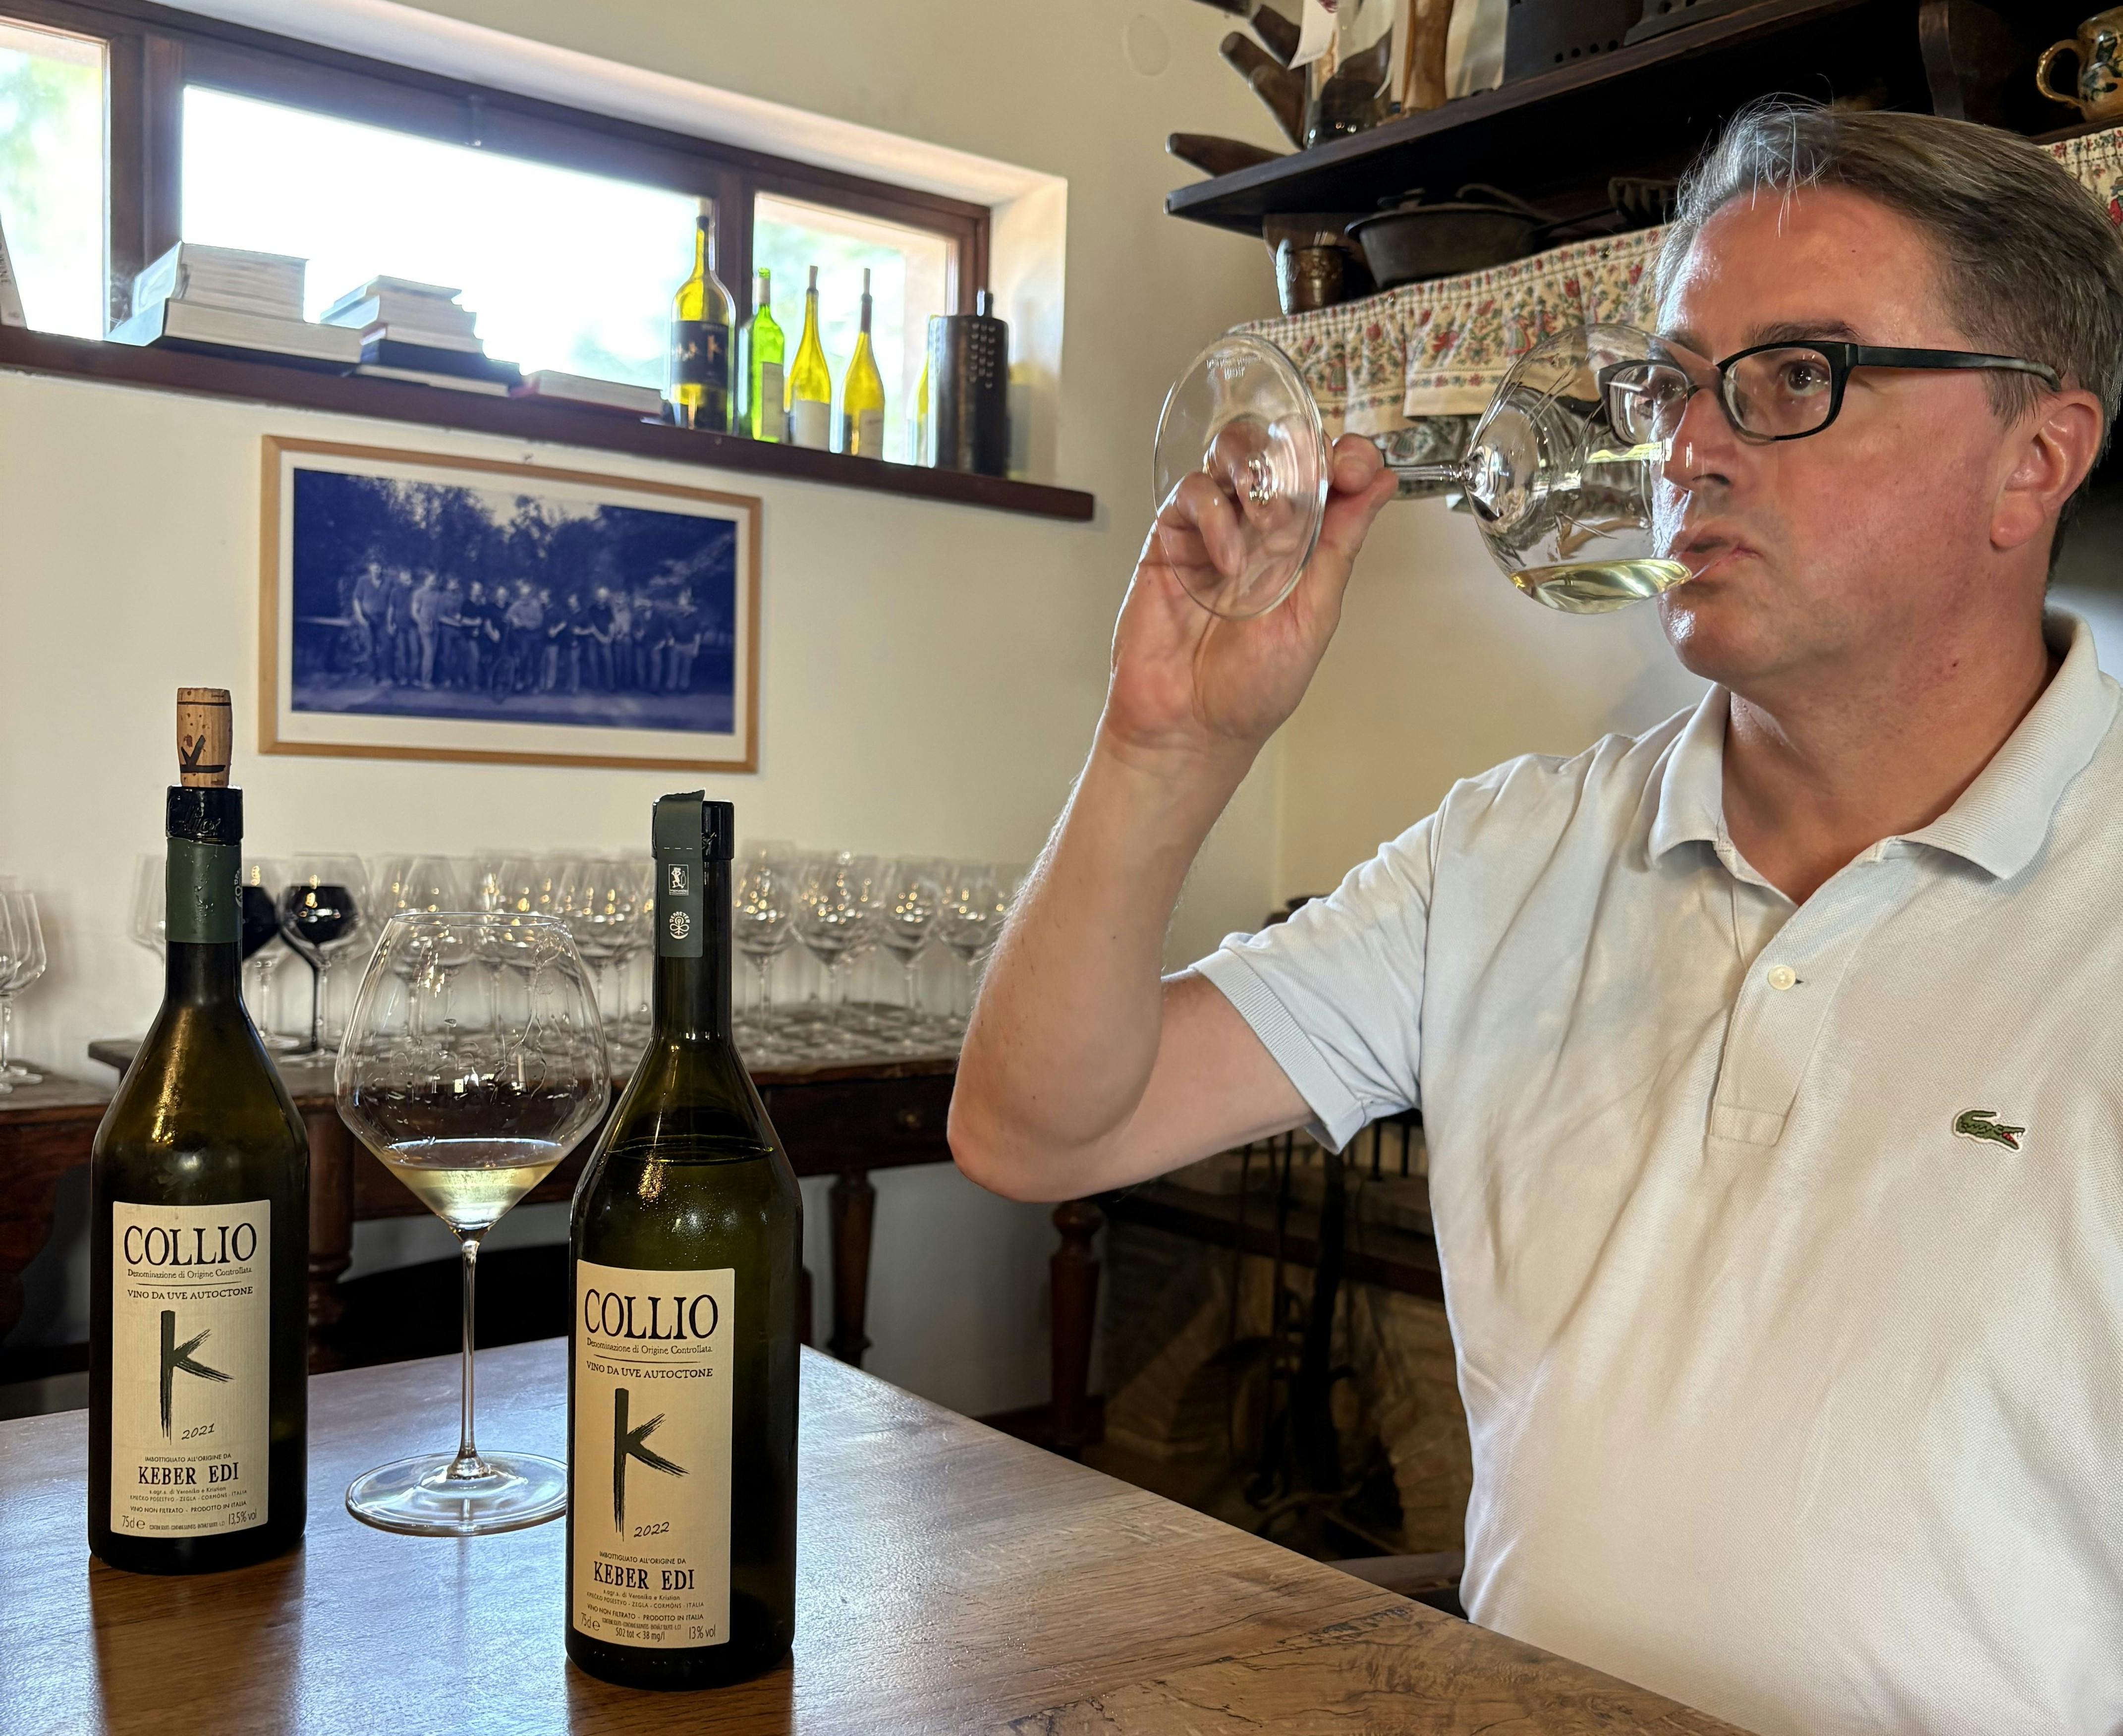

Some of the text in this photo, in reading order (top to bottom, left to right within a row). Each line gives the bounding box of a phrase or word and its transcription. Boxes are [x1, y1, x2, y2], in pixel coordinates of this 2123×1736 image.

[669, 911, 690, 924] DEMETER
[124, 1223, 257, 1266] COLLIO
[127, 1266, 253, 1280] Denominazione di Origine Controllata
[127, 1289, 149, 1299] VINO
[190, 1286, 253, 1300] AUTOCTONE
[585, 1288, 718, 1340] COLLIO
[587, 1337, 713, 1355] Denominazione di Origine Controllata
[586, 1360, 713, 1379] VINO DA UVE AUTOCTONE
[181, 1423, 215, 1440] 2021
[187, 1454, 222, 1462] ALL'ORIGINE
[138, 1462, 239, 1485] KEBER EDI
[228, 1511, 247, 1525] 13,5%
[248, 1508, 257, 1520] vol
[634, 1521, 670, 1538] 2022
[599, 1551, 638, 1563] IMBOTTIGLIATO
[593, 1561, 695, 1590] KEBER EDI
[587, 1603, 599, 1612] VINO
[613, 1611, 636, 1620] FILTRATO
[643, 1631, 650, 1640] 38
[651, 1631, 665, 1642] mg/l
[689, 1624, 716, 1639] 13% vol
